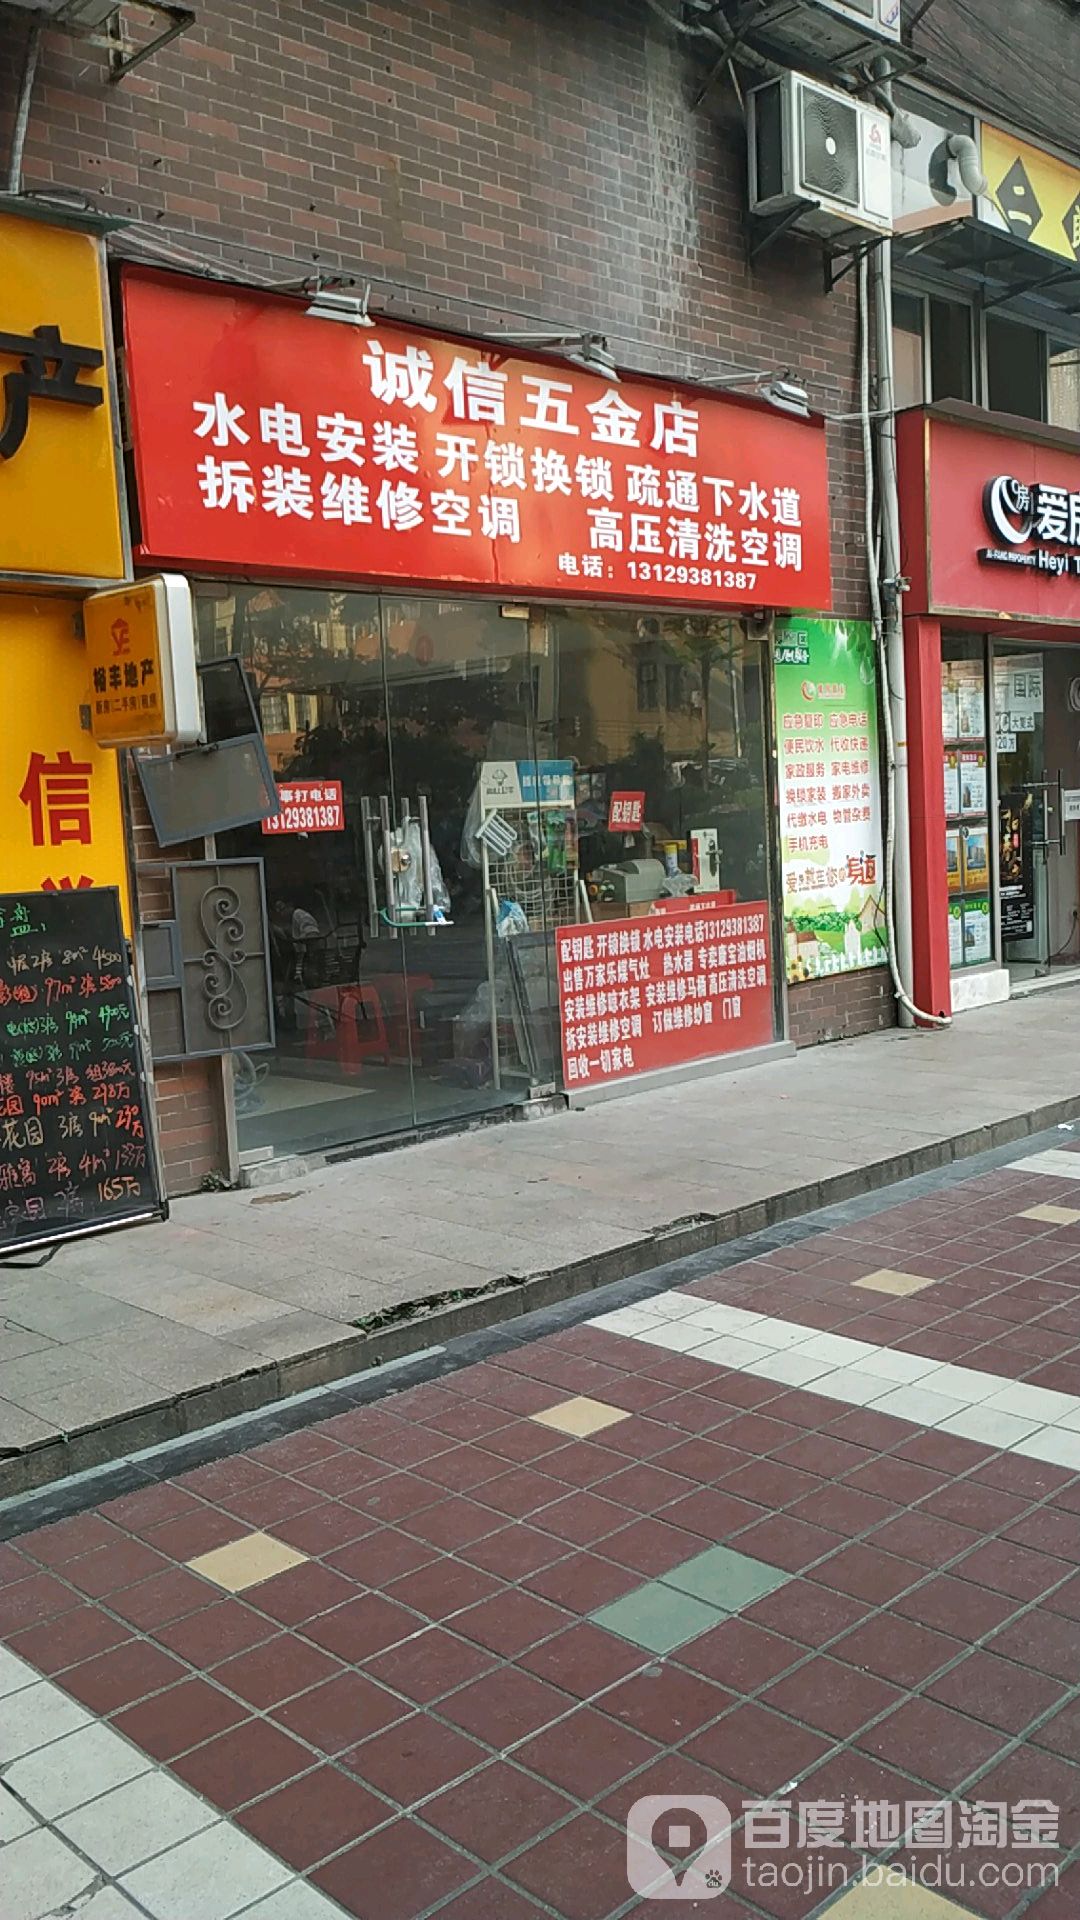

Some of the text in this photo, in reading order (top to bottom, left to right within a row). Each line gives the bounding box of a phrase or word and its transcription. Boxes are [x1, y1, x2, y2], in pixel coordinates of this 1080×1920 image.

[363, 339, 700, 460] 诚信五金店
[193, 392, 802, 529] 水电安装 开锁换锁 疏通下水道
[197, 456, 521, 544] 拆装维修空调
[587, 506, 803, 572] 高压清洗空调
[627, 561, 757, 590] 13129381387
[1039, 549, 1069, 576] Heyi
[19, 751, 95, 892] 信
[266, 805, 340, 830] 13129381387
[788, 834, 829, 853] 手机充电
[560, 935, 594, 963] 配钥匙
[597, 929, 642, 958] 开锁换锁
[563, 956, 650, 993] 出售万家乐煤气灶
[663, 949, 694, 976] 热水器
[709, 964, 767, 996] 高压清洗空调
[722, 996, 741, 1020] 门窗
[567, 1044, 635, 1081] 回收一切家电
[98, 1175, 141, 1202] 165万
